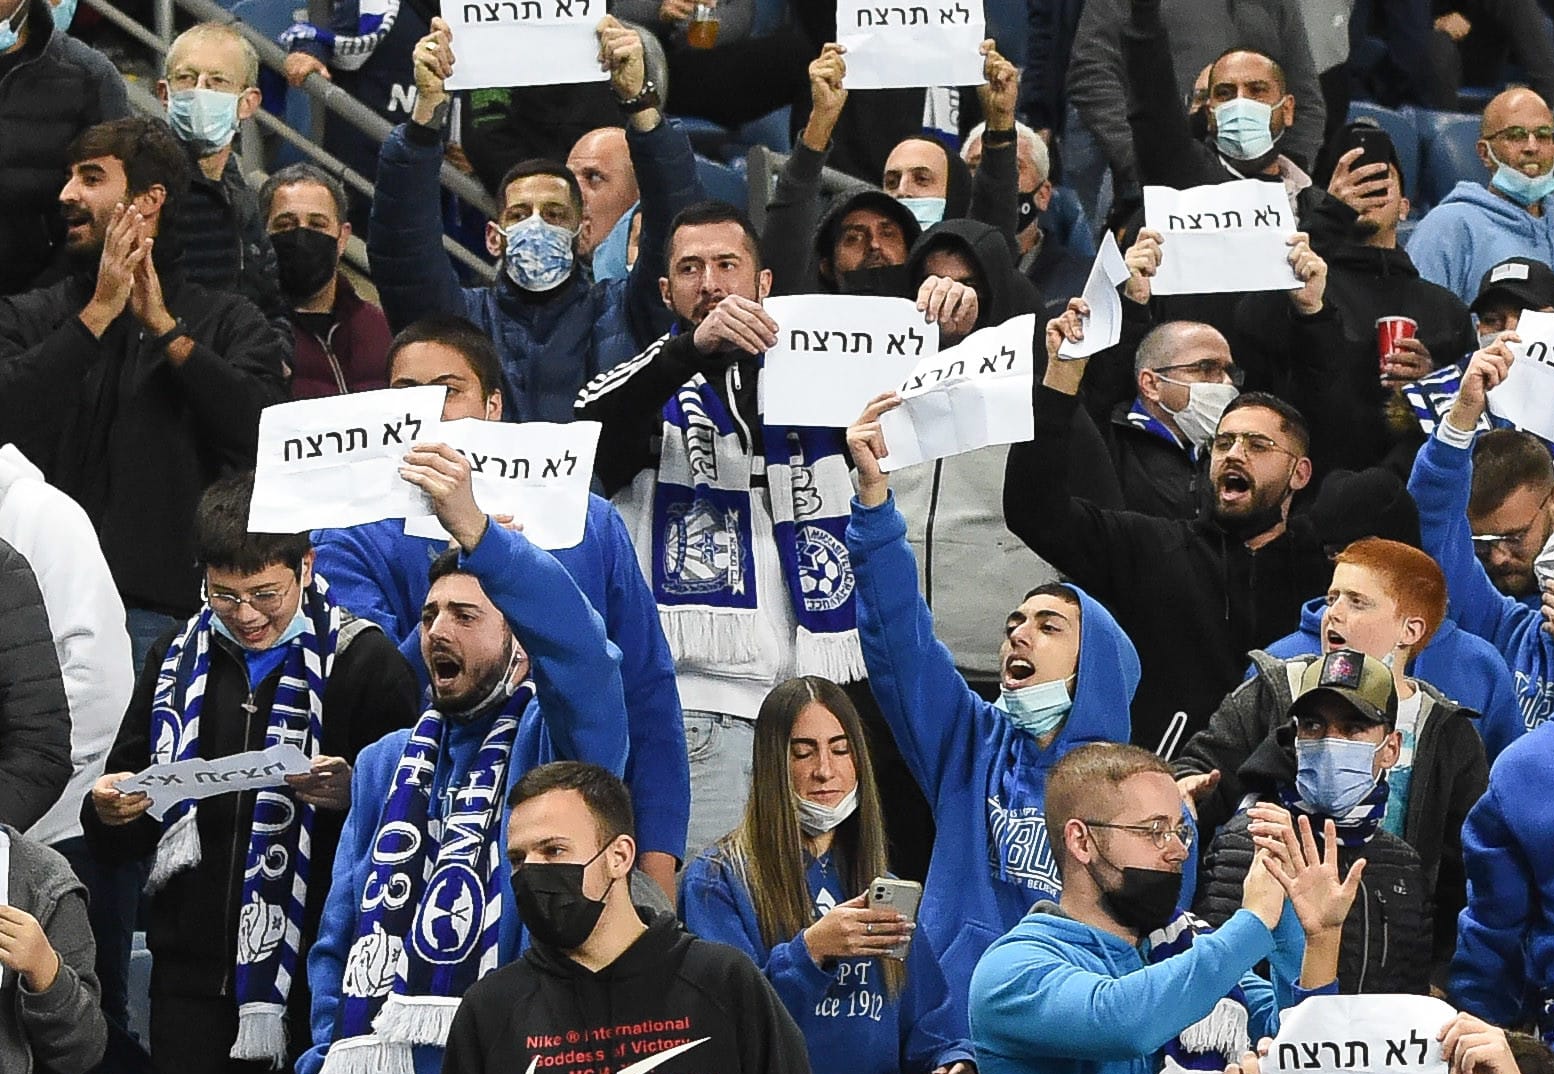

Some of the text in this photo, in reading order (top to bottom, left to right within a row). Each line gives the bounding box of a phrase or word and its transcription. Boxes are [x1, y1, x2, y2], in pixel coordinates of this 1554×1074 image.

[463, 0, 590, 23] לא תרצח
[857, 2, 970, 27] לא תרצח
[1168, 205, 1281, 230] לא תרצח
[790, 327, 924, 356] לא תרצח
[979, 346, 1016, 374] לא
[284, 413, 422, 462] לא תרצח
[456, 449, 578, 479] לא תרצ
[847, 990, 883, 1022] 1912
[526, 1035, 562, 1049] Nike
[1279, 1029, 1428, 1070] לא תרצח
